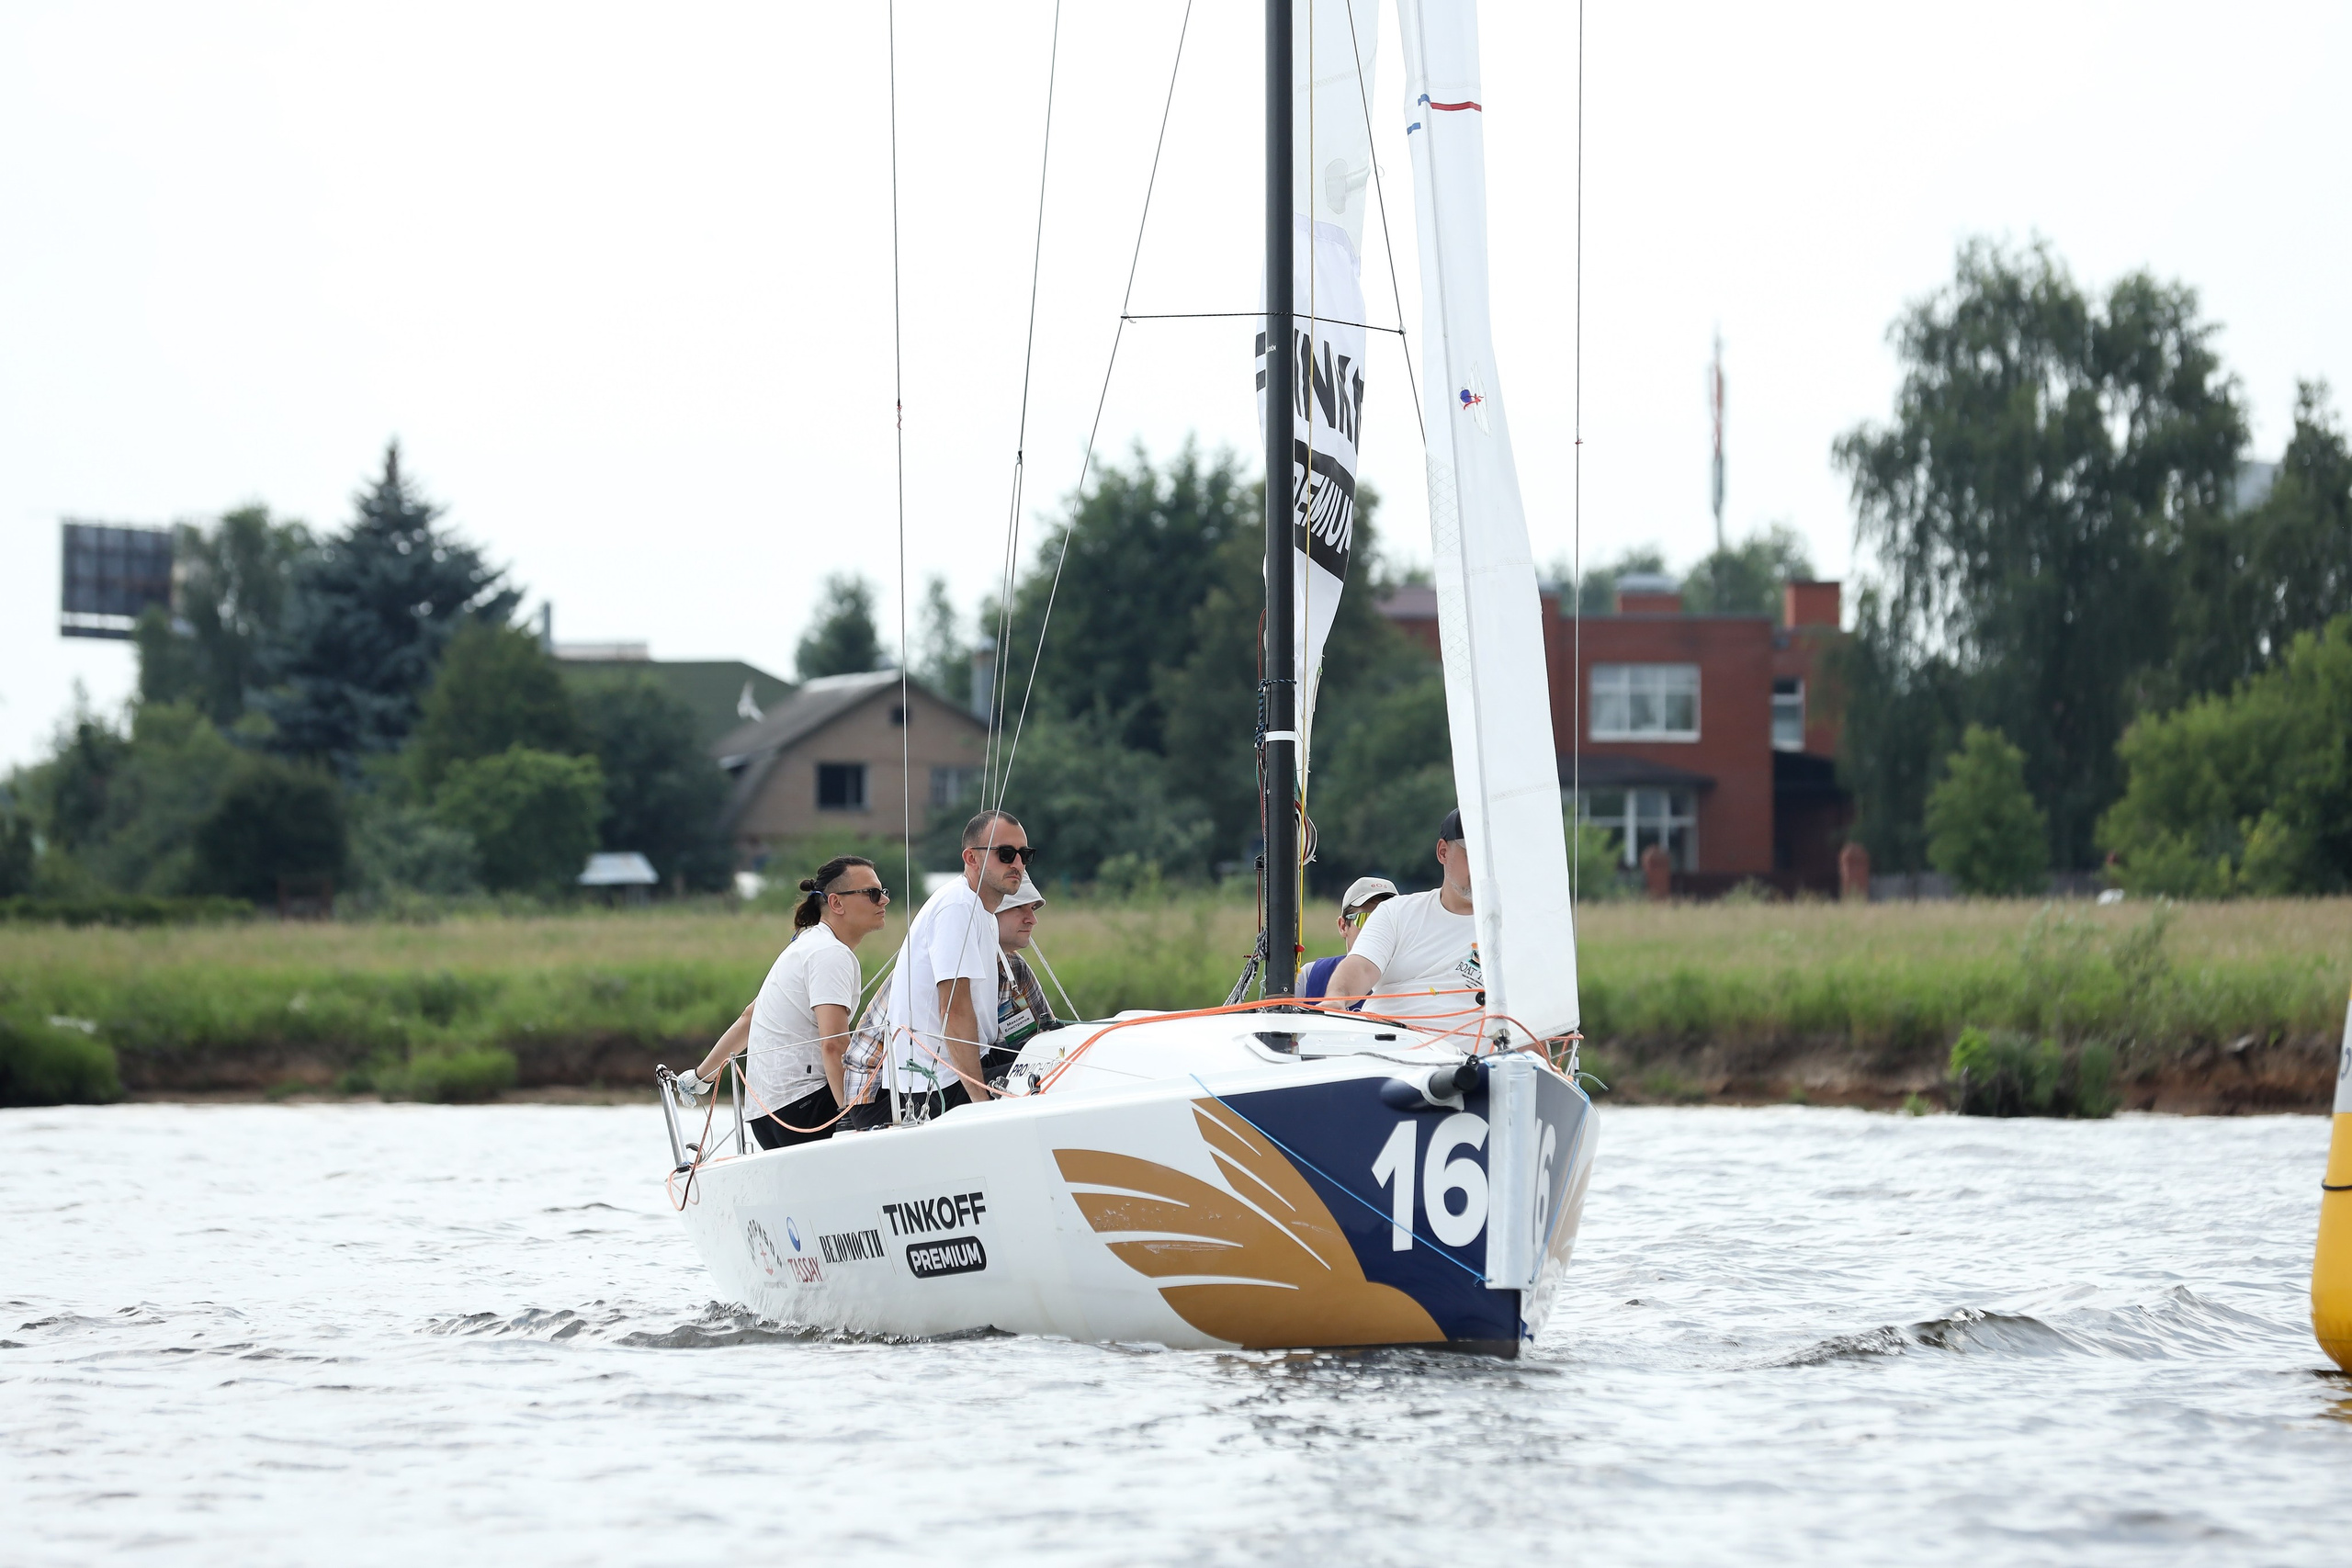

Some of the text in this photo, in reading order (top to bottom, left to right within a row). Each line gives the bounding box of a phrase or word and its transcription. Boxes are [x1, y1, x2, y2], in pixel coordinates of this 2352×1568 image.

[1372, 1112, 1489, 1252] 16
[882, 1191, 987, 1236] TINKOFF
[819, 1229, 885, 1265] ВЕДОМОСТИ
[910, 1242, 982, 1272] PREMIUM
[787, 1257, 823, 1283] TASSAY
